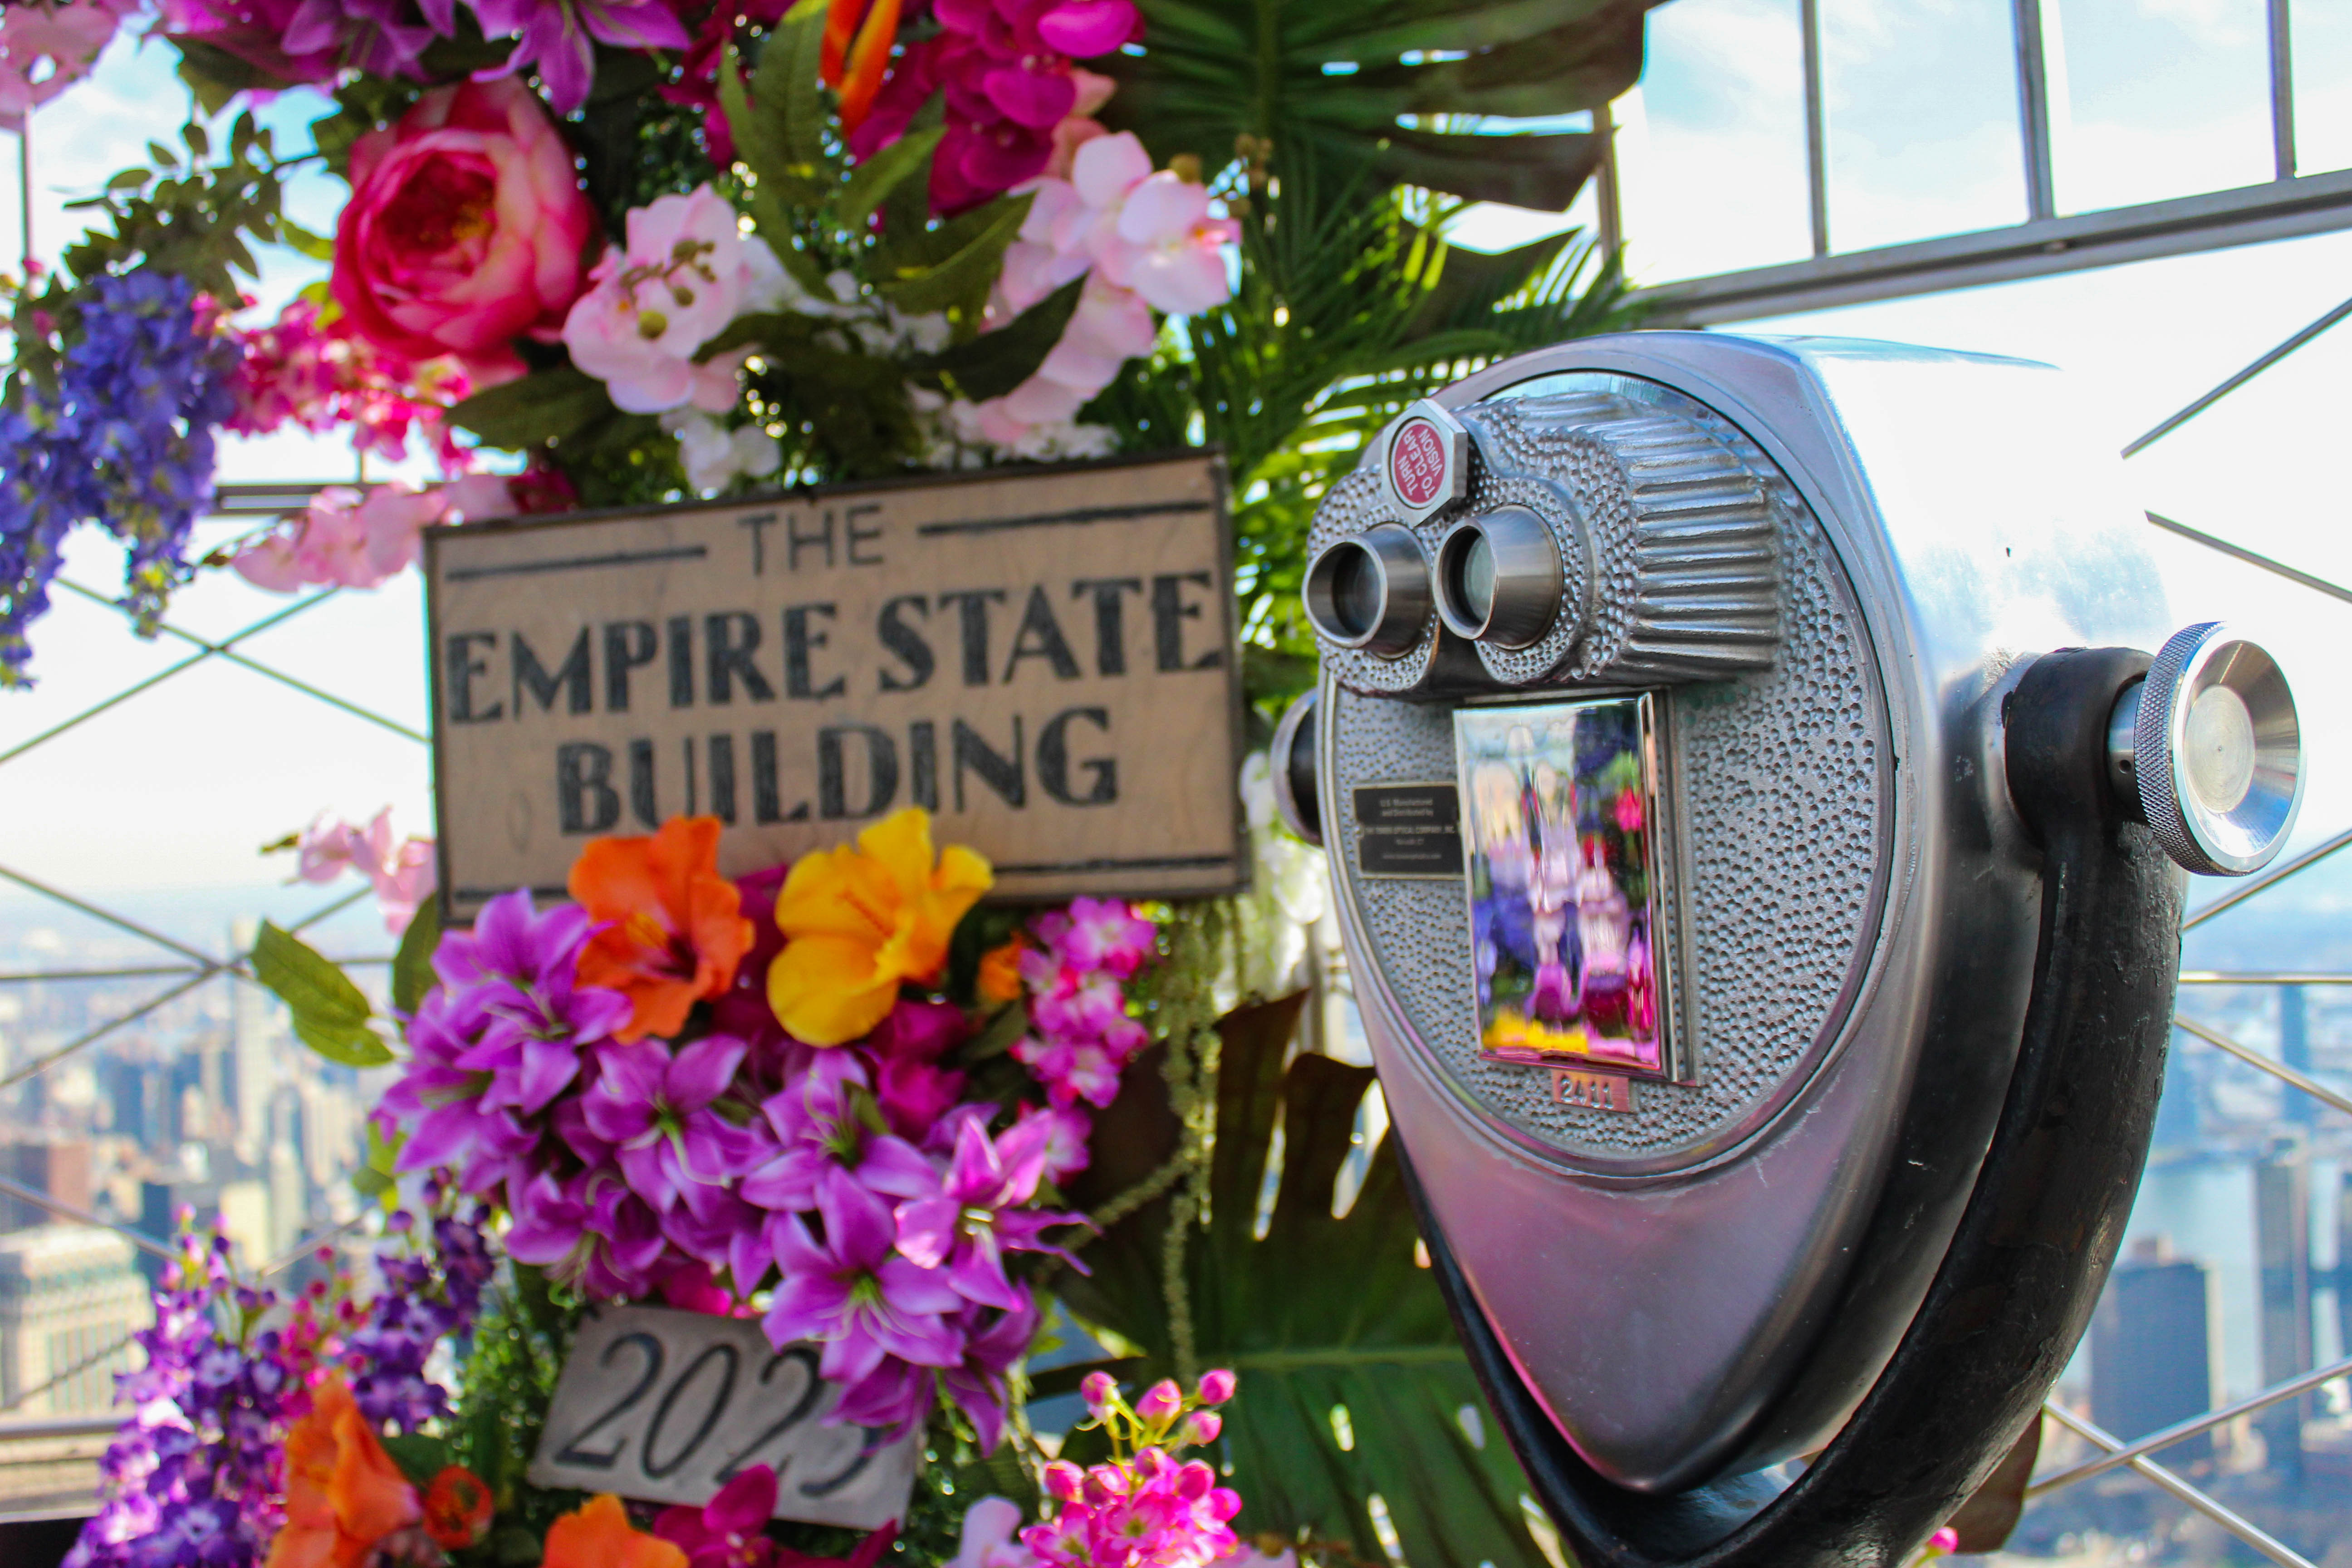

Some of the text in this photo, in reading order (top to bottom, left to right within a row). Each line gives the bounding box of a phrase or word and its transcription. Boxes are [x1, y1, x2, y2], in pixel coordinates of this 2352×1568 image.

[1397, 455, 1419, 496] TURN
[1403, 429, 1436, 499] TO CLEAR
[1419, 428, 1443, 477] VISION
[736, 503, 885, 575] THE
[448, 570, 1224, 724] EMPIRE STATE
[556, 706, 1120, 836] BUILDING
